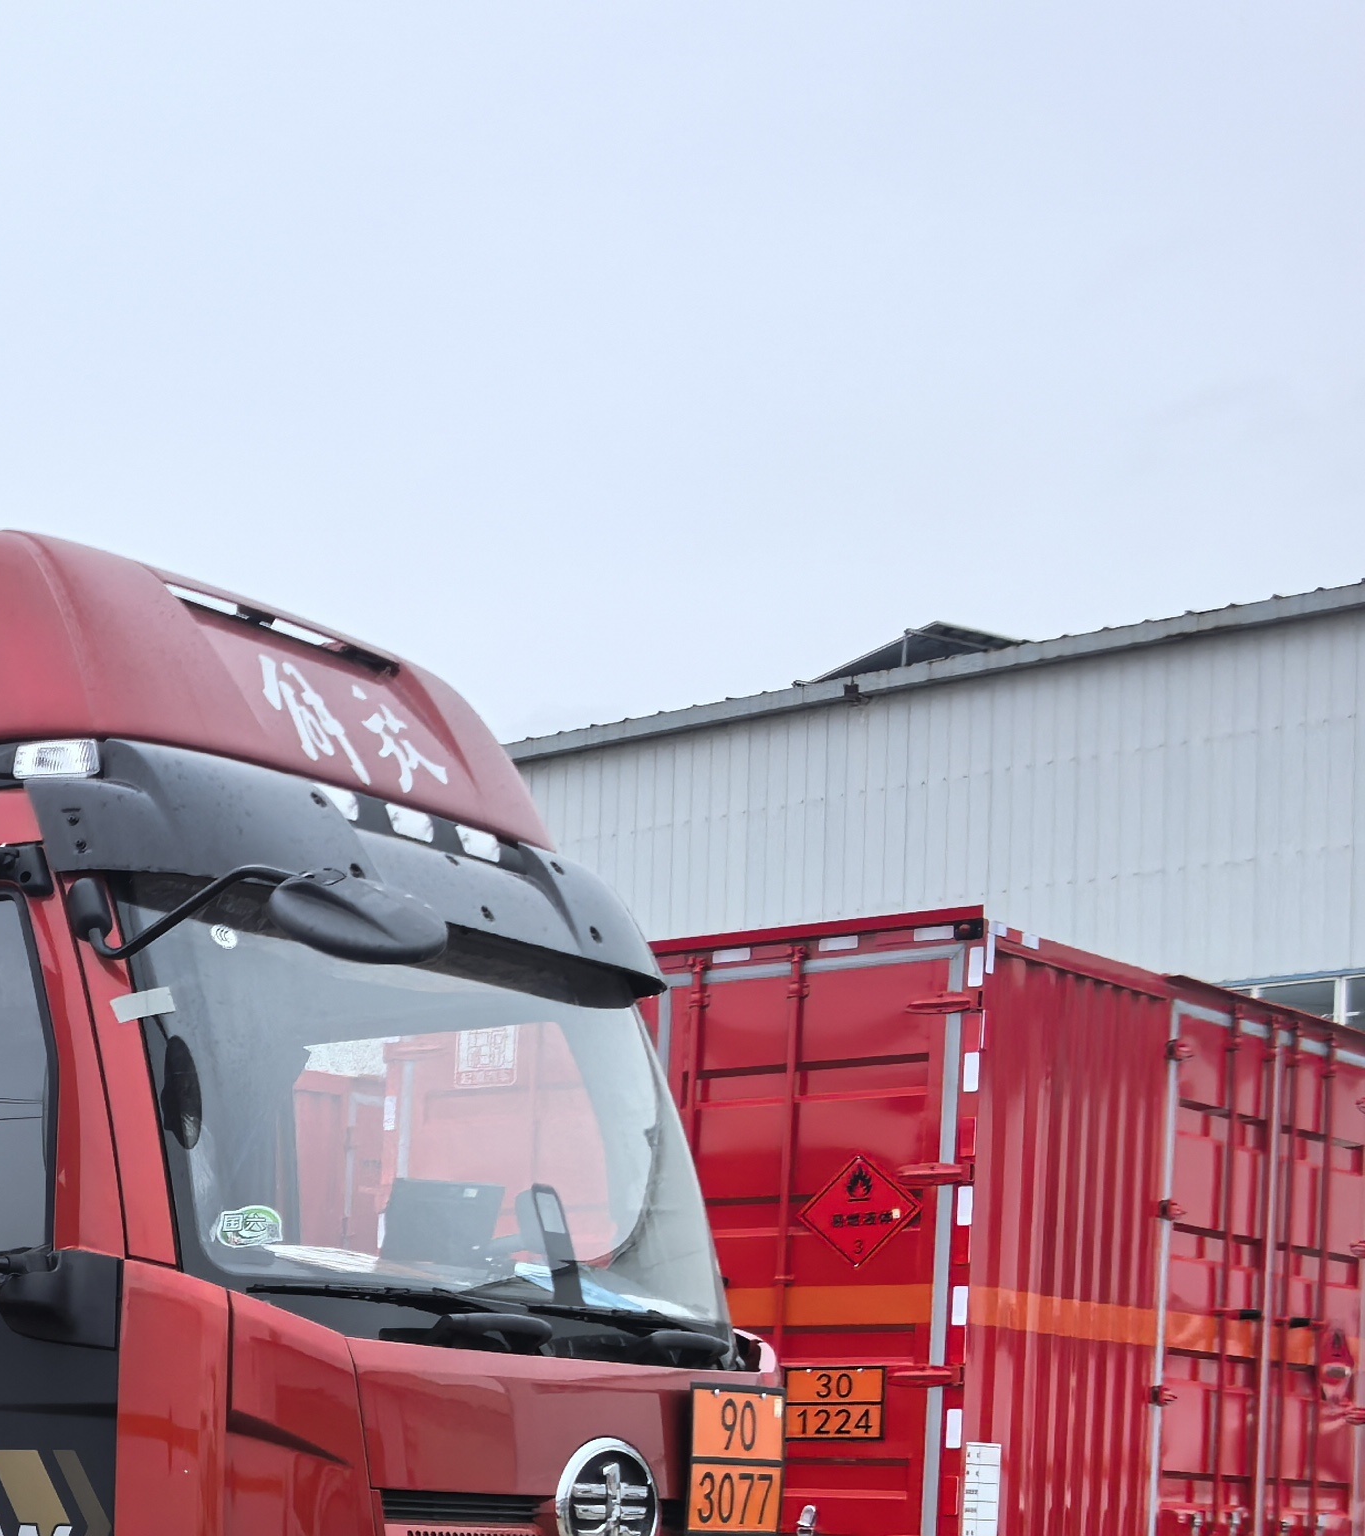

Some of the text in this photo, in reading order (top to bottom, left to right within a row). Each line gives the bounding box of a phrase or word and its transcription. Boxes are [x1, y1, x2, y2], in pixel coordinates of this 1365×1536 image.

[222, 1212, 267, 1232] 国六
[853, 1239, 864, 1255] 3
[815, 1373, 852, 1399] 30
[720, 1398, 757, 1451] 90
[797, 1408, 872, 1435] 1224
[697, 1471, 773, 1525] 3077
